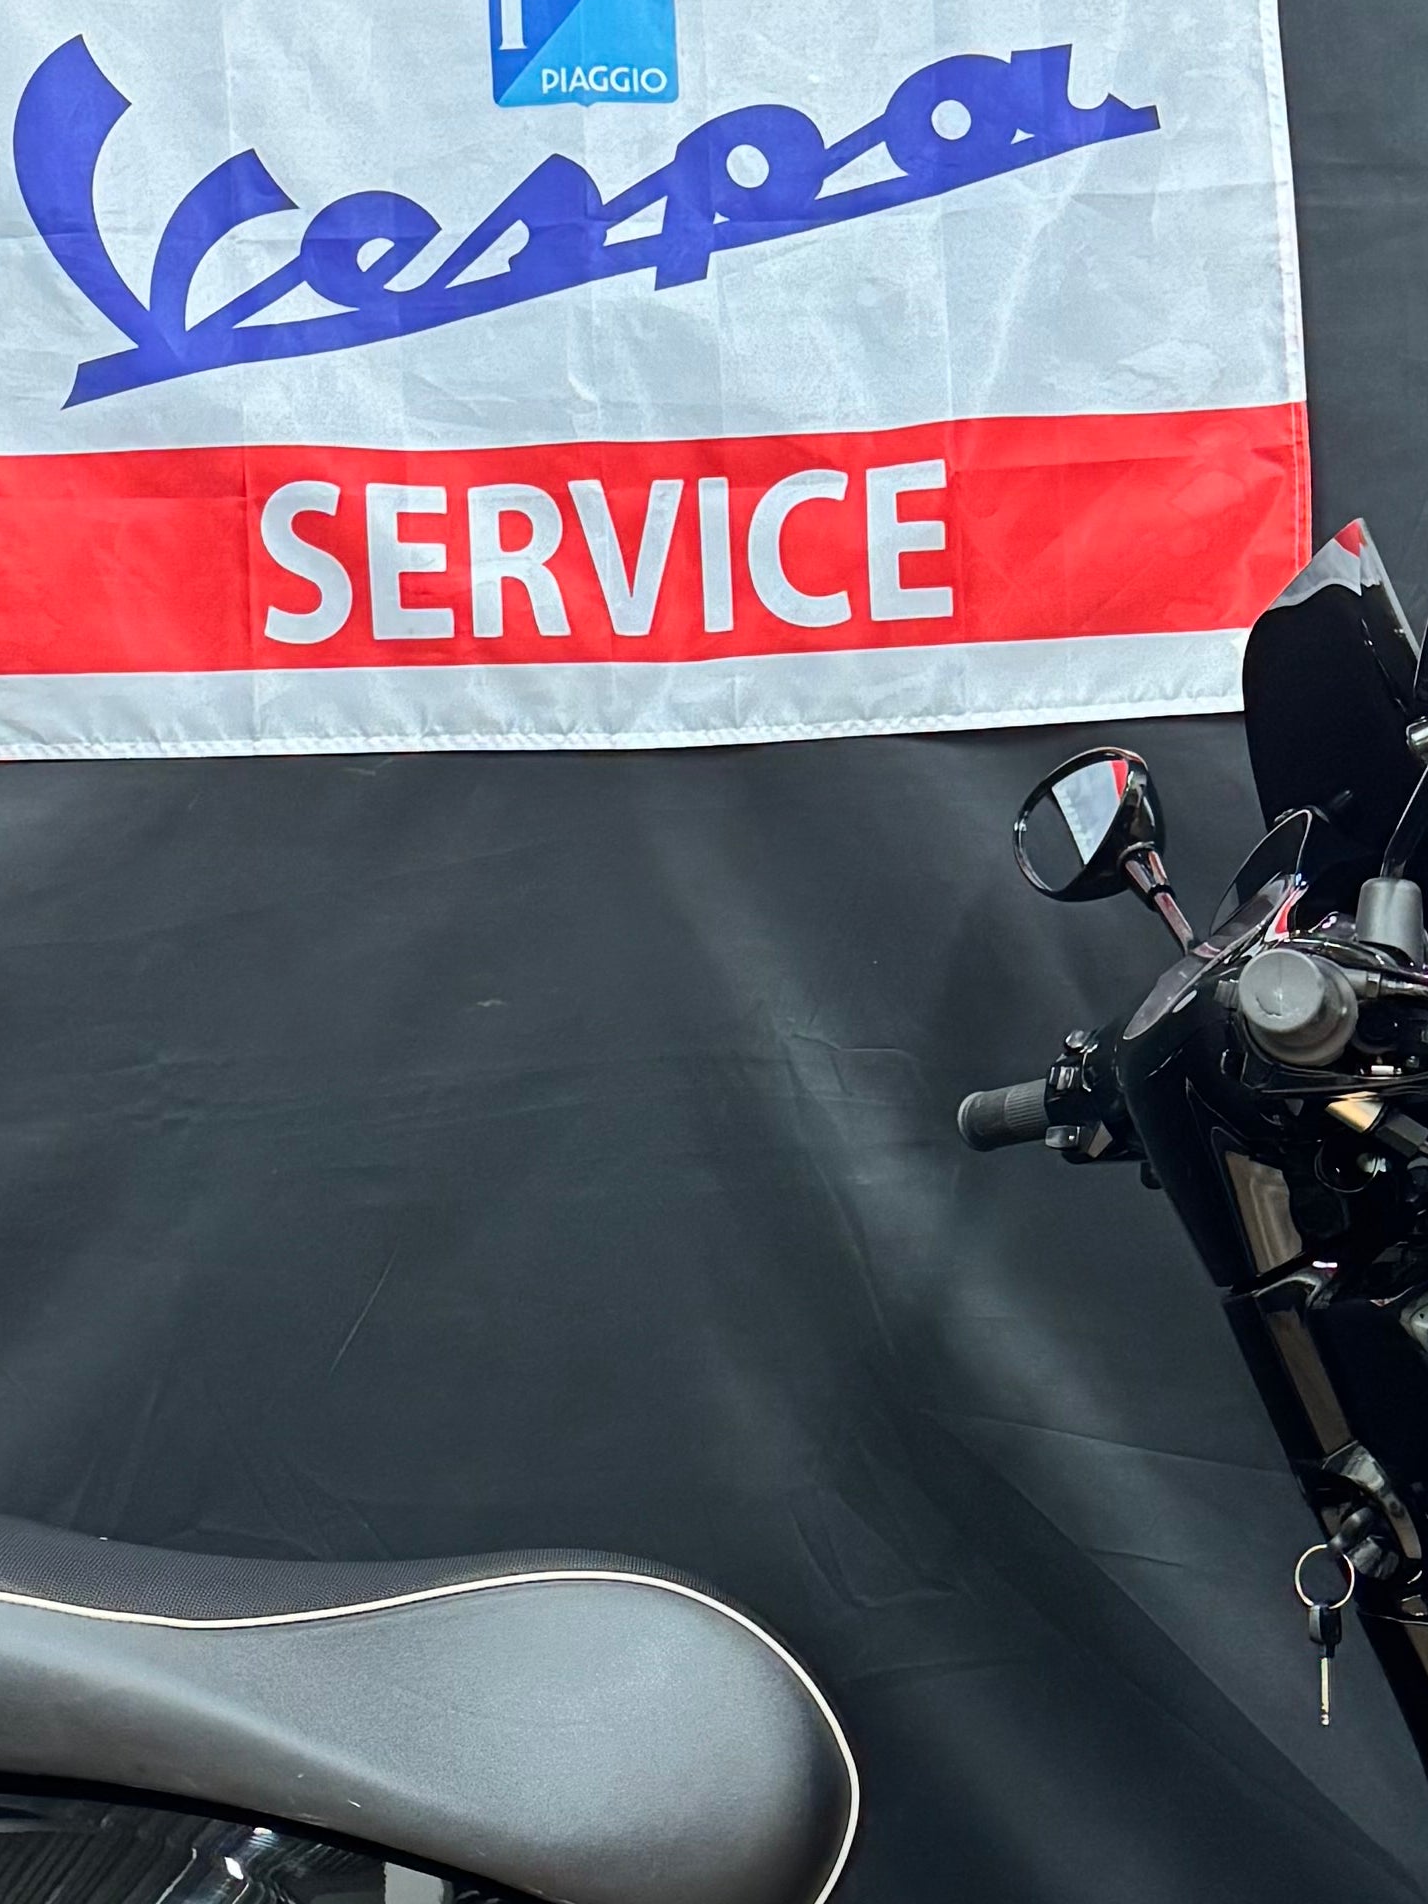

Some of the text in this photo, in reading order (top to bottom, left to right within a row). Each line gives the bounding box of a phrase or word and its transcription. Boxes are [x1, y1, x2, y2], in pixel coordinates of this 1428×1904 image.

[541, 64, 668, 95] PIAGGIO
[12, 33, 1160, 410] Vespa
[258, 458, 954, 647] SERVICE
